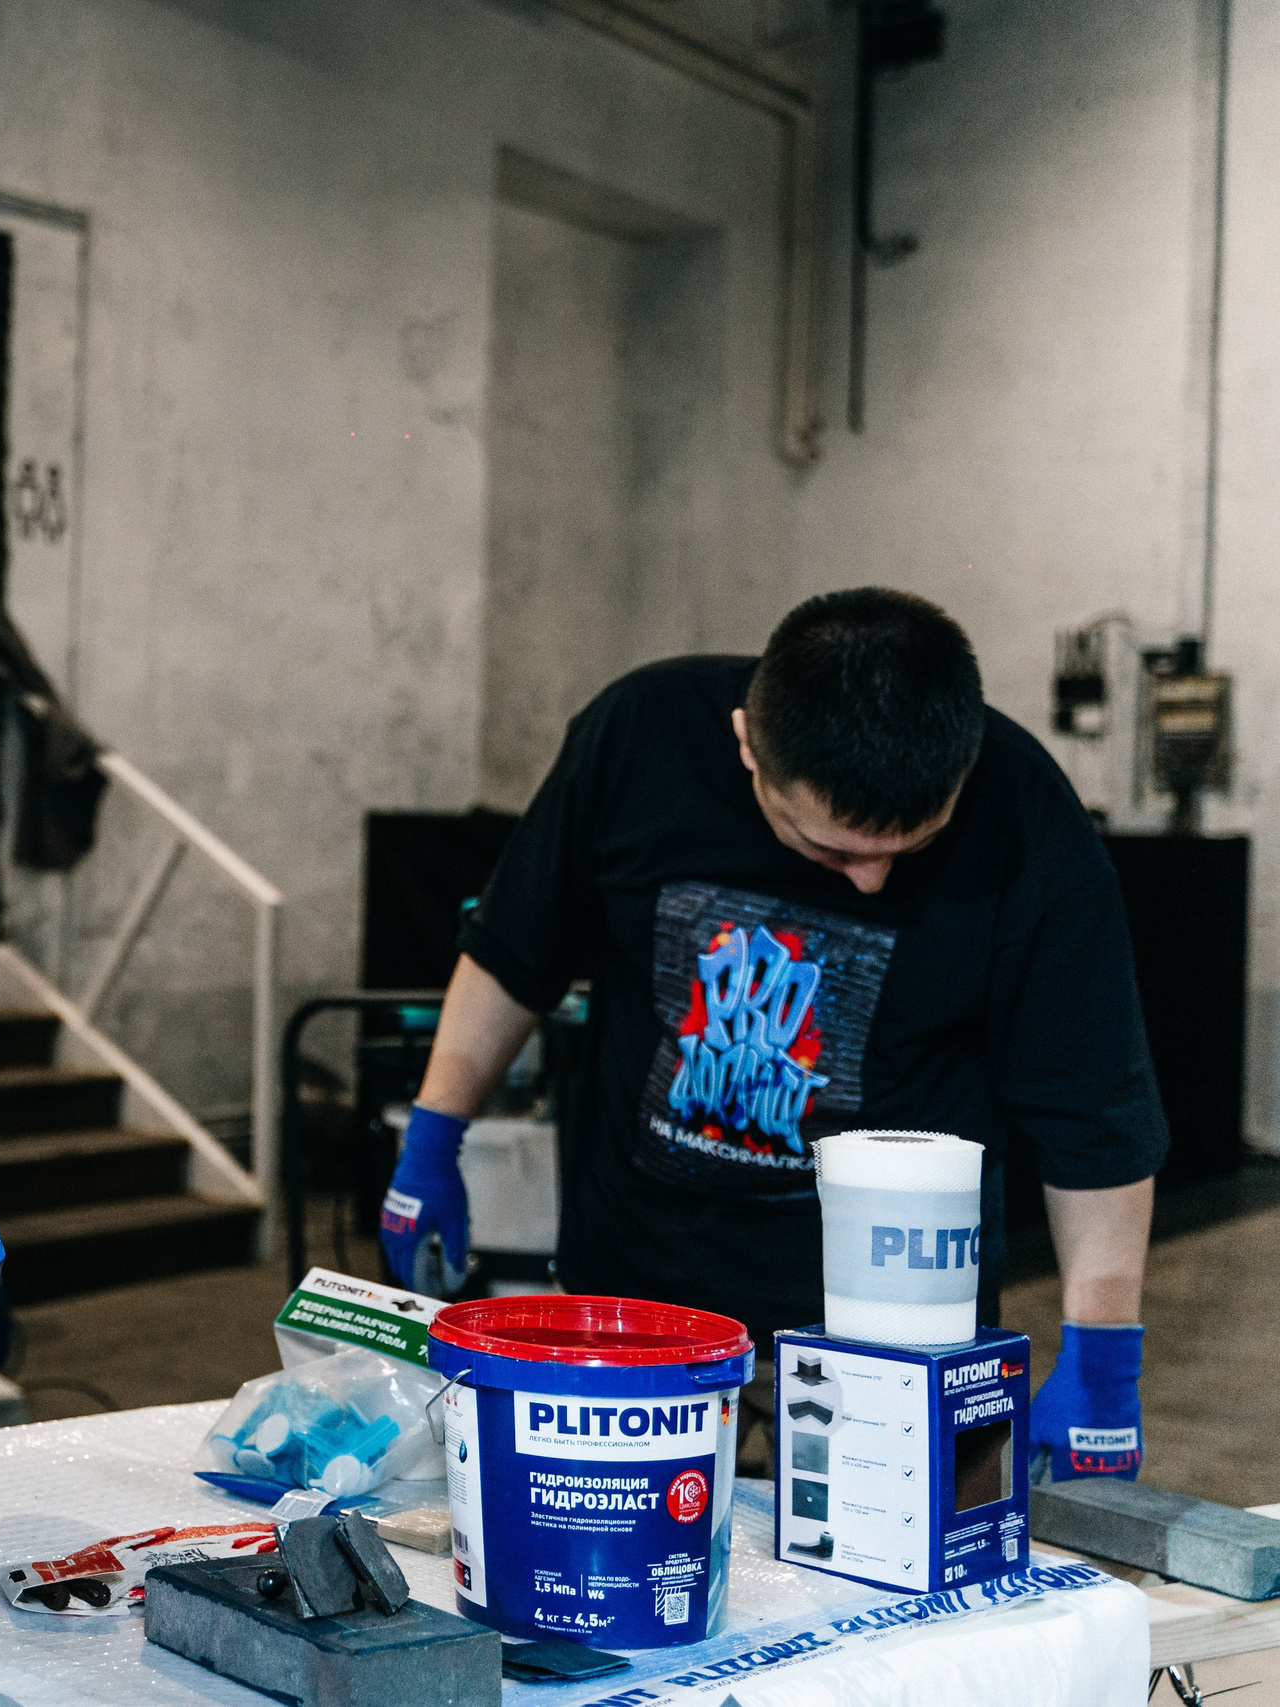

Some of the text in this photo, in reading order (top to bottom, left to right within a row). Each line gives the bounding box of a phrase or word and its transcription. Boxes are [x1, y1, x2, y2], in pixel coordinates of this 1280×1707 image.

[649, 1114, 673, 1140] НА
[296, 1299, 401, 1334] РЕПЕРНЫЕ МАЯЧКИ
[288, 1309, 408, 1350] ДЛЯ НАЛИВНОГО ПОЛА
[944, 1358, 1000, 1389] PLITONIT
[529, 1401, 709, 1437] PLITONIT
[954, 1396, 1014, 1425] ГИДРОЛЕНТА
[529, 1435, 552, 1443] ЛЕГКО
[529, 1471, 649, 1491] ГИДРОИЗОЛЯЦИЯ
[530, 1487, 660, 1510] ГИДРОЭЛАСТ
[679, 1501, 700, 1510] ЦИКЛОВ
[531, 1511, 636, 1526] Эластичная гидроизоляционная
[531, 1520, 557, 1529] мастика
[567, 1524, 609, 1533] полимерной
[651, 1562, 702, 1576] ОБЛИЦОВКА
[665, 1557, 691, 1565] ПРОДУКТОВ
[534, 1569, 562, 1577] УСИЛЕННАЯ
[535, 1581, 576, 1596] 1,5 МПа
[981, 1563, 1100, 1604] PLITONI
[588, 1589, 605, 1600] W6
[534, 1607, 544, 1621] 4
[663, 1631, 833, 1688] PLITONIT
[698, 1644, 846, 1693] ЛЕГКО БЫТЬ ПРОФЕССИОНАЛОМ
